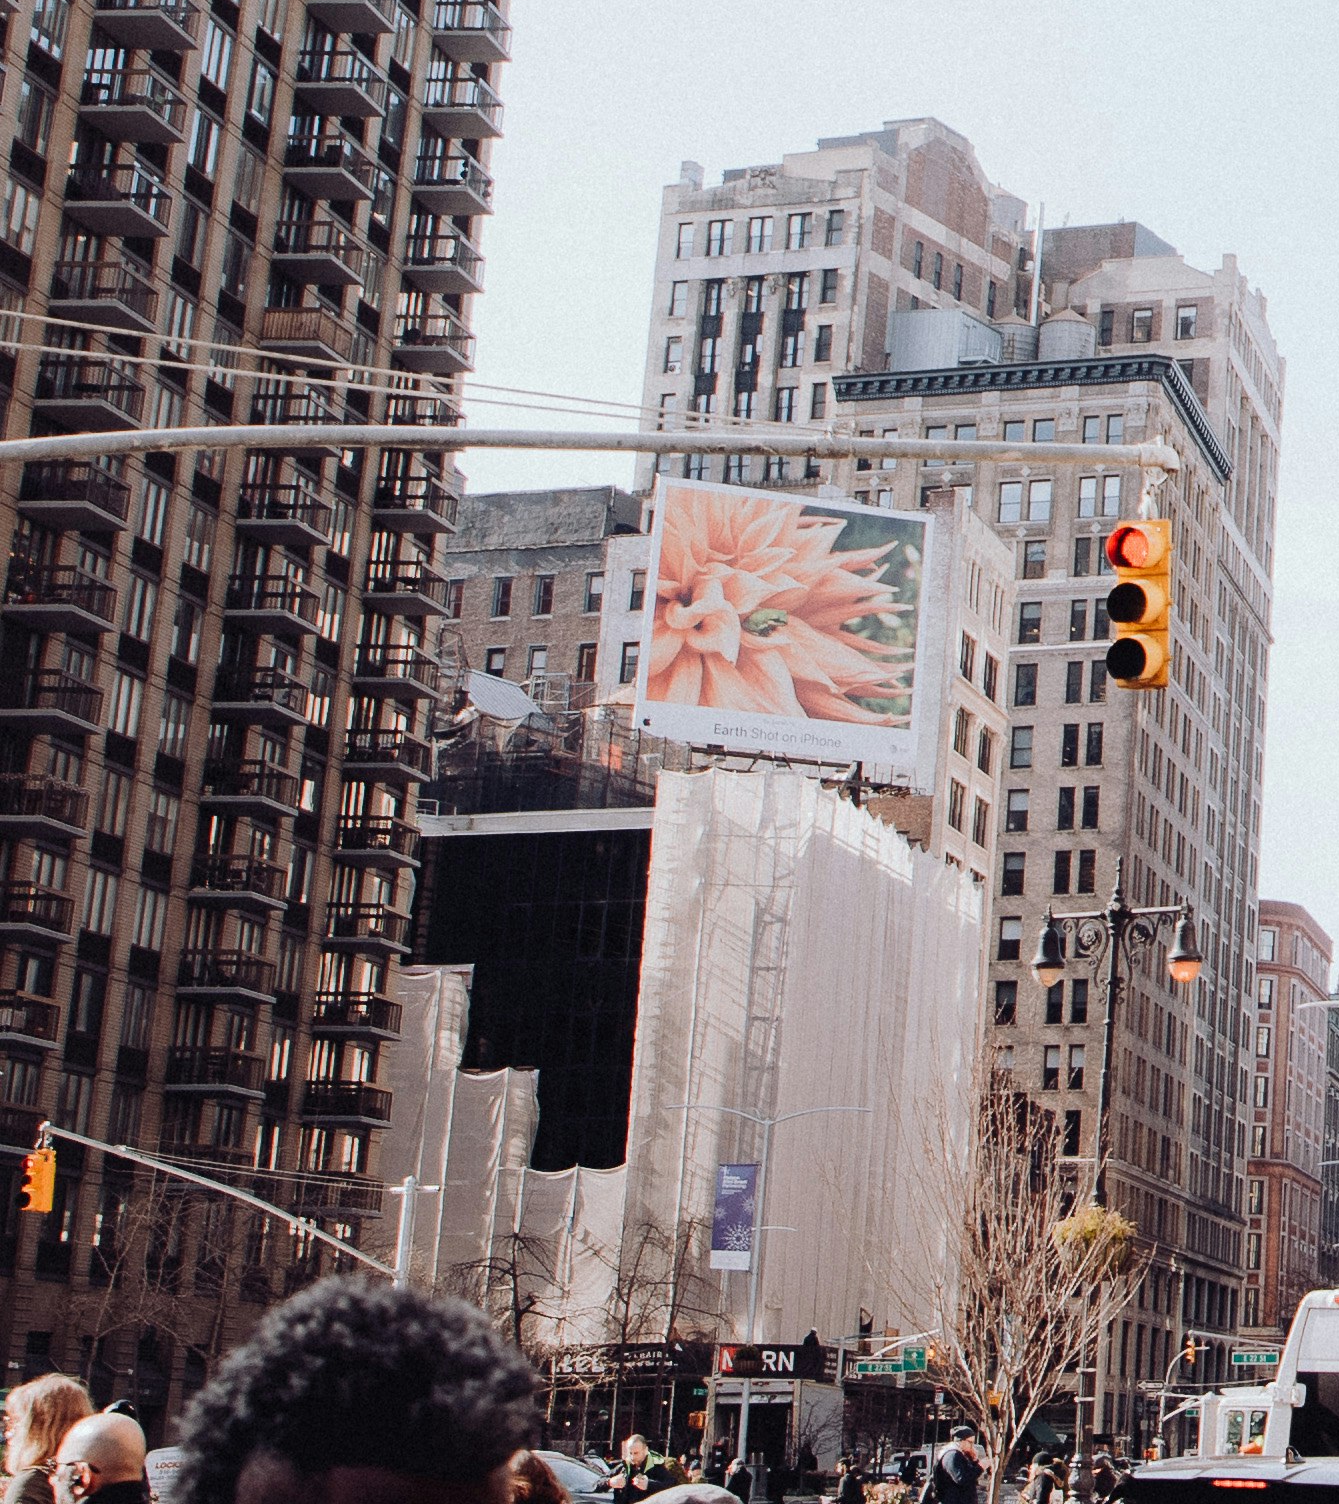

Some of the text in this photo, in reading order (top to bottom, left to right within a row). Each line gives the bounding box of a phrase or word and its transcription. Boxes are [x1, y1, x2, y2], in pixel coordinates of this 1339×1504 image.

[713, 723, 748, 739] Earth
[751, 728, 779, 741] Shot
[782, 732, 797, 744] on
[800, 732, 842, 749] iPhone
